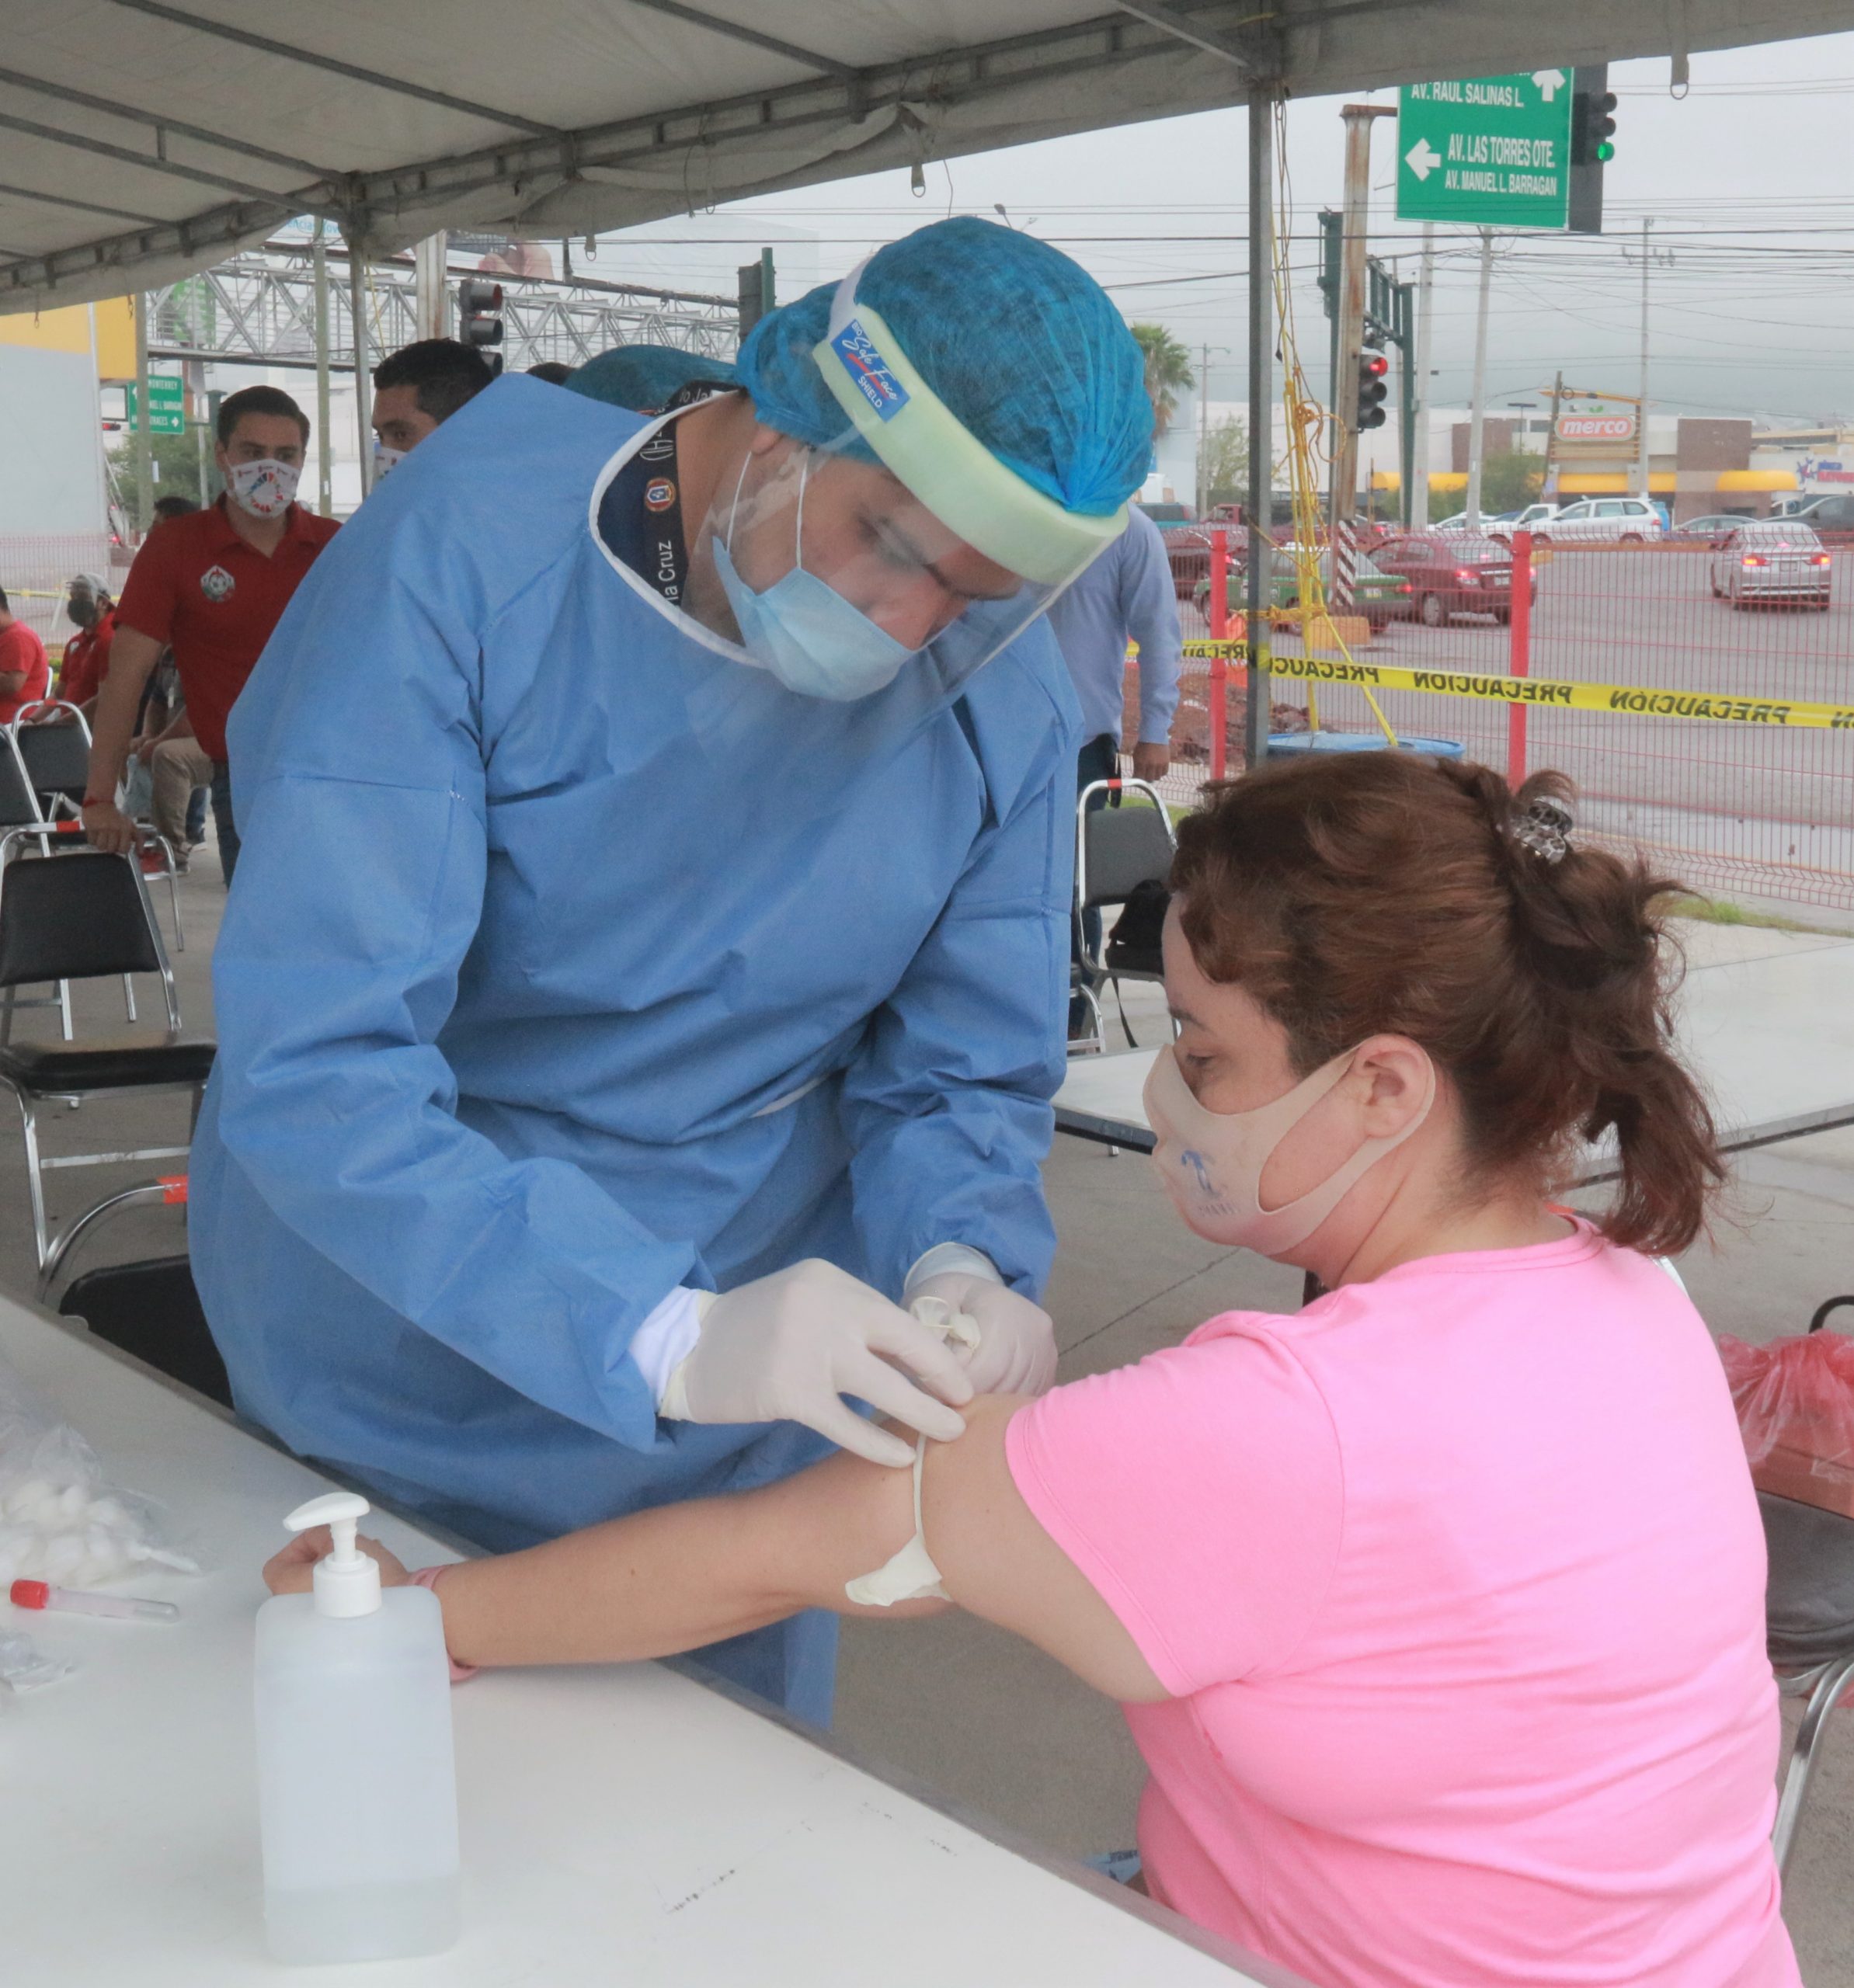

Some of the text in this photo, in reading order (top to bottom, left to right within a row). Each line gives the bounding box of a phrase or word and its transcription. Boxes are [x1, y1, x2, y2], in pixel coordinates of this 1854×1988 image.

[1411, 82, 1524, 108] AV. RAUL SALINAS L.
[1448, 133, 1556, 169] AV. LAS TORRES OTE.
[1445, 169, 1557, 196] AV. MANUEL L. BARRAGAN
[851, 321, 863, 337] BIO
[841, 336, 898, 401] Safe Face
[857, 376, 883, 408] SHIELD
[1562, 420, 1629, 435] merco
[658, 540, 677, 582] Cruz
